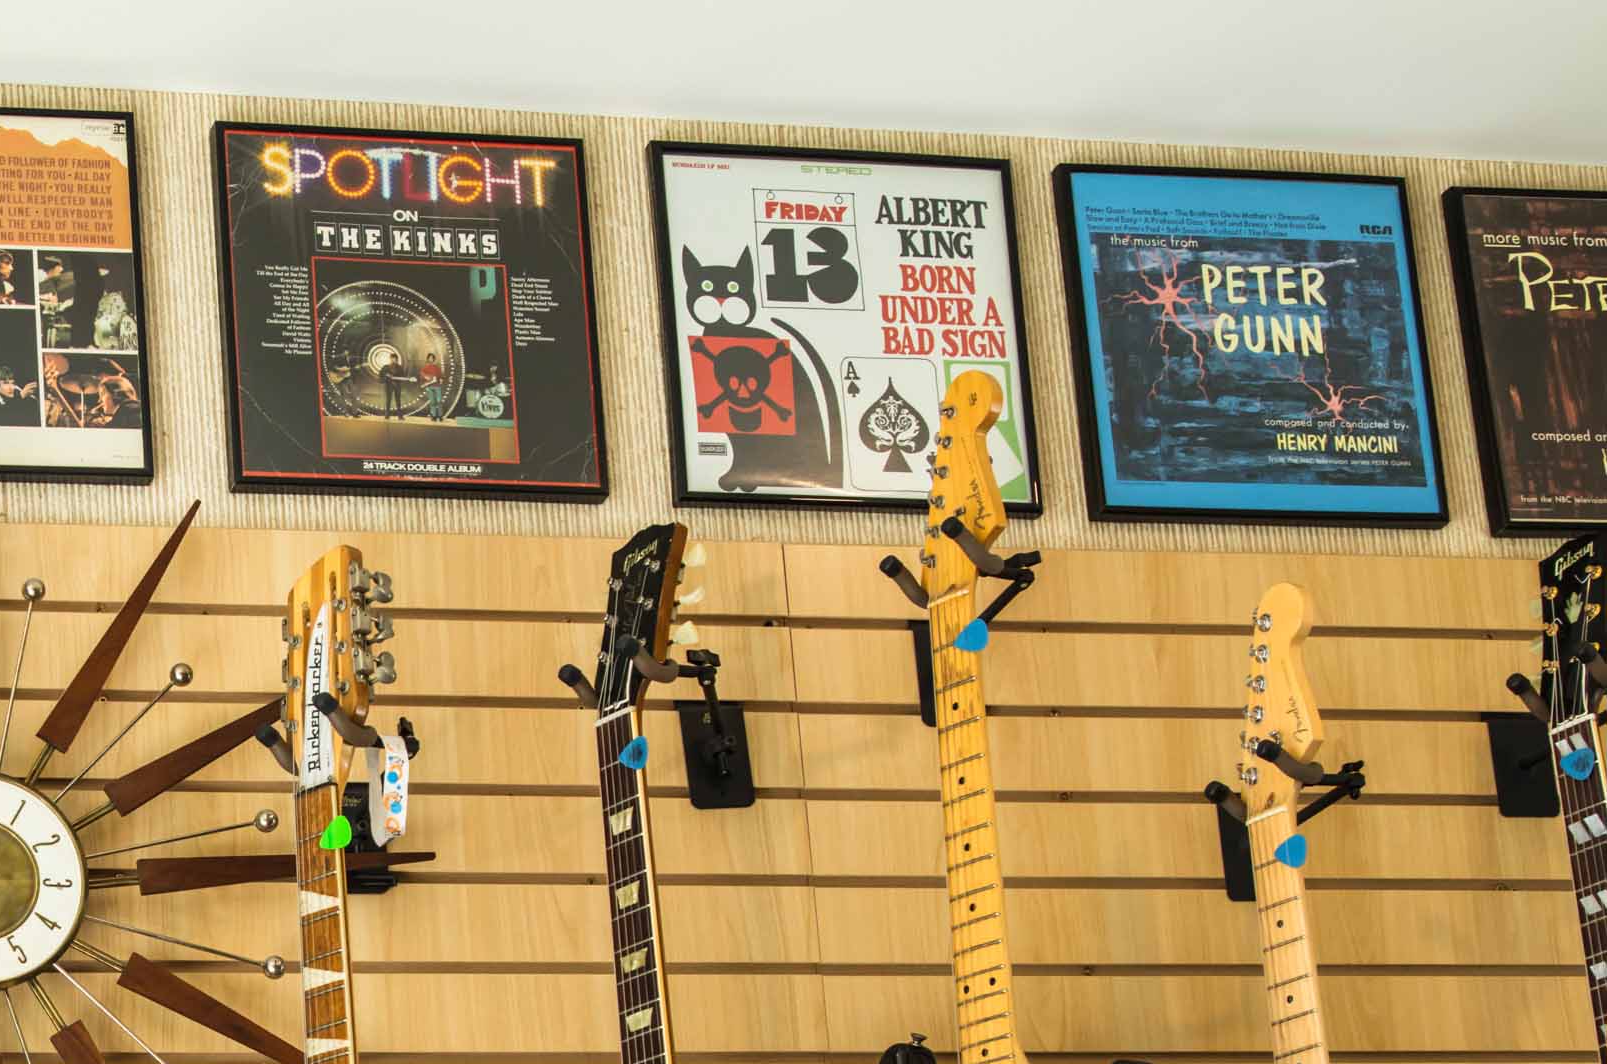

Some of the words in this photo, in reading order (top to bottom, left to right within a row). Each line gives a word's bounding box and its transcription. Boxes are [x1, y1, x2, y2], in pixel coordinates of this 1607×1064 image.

[8, 156, 56, 167] FOLLOWER
[58, 157, 69, 167] OF
[72, 158, 111, 169] FASHION
[26, 169, 44, 179] FOR
[48, 170, 66, 180] YOU
[74, 172, 90, 181] ALL
[93, 172, 111, 181] DAY
[260, 142, 556, 208] SPOTLIGHT
[19, 182, 48, 192] NIGHT
[54, 184, 74, 193] YOU
[77, 184, 112, 195] REALLY
[0, 194, 25, 204] WELL
[25, 196, 86, 205] RESPECTED
[90, 197, 113, 207] MAN
[8, 206, 31, 217] LINE
[44, 207, 114, 219] EVERYBODY'S
[393, 209, 419, 222] ON
[764, 201, 848, 223] FRIDAY
[875, 194, 988, 229] ALBERT
[9, 220, 25, 229] THE
[72, 221, 89, 232] THE
[1359, 224, 1393, 235] RCA
[316, 225, 382, 251] THE
[392, 227, 498, 256] KINKS
[897, 229, 974, 259] KING
[1111, 234, 1128, 246] the
[1134, 236, 1166, 247] music
[1170, 235, 1199, 248] from
[1483, 234, 1521, 244] more
[1527, 232, 1569, 246] music
[761, 227, 859, 304] 13
[899, 264, 977, 295] BORN
[1201, 264, 1327, 306] PETER
[879, 294, 977, 326] UNDER
[983, 296, 1004, 327] A
[881, 326, 935, 356] BAD
[942, 328, 1007, 358] SIGN
[1214, 313, 1324, 357] GUNN
[843, 361, 861, 380] A
[1264, 418, 1313, 429] composed
[1317, 418, 1335, 428] and
[1341, 419, 1389, 429] conducted
[1276, 433, 1327, 451] HENRY
[1334, 435, 1398, 453] MANCINI
[1531, 429, 1591, 443] composed
[376, 462, 407, 471] TRACK
[407, 464, 445, 472] DOUBLE
[447, 465, 481, 473] ALBUM
[1555, 541, 1593, 580] Gibson
[10, 800, 26, 825] 1
[32, 833, 61, 853] 2
[43, 878, 73, 888] 3
[34, 911, 62, 931] 4
[7, 935, 27, 964] 5
